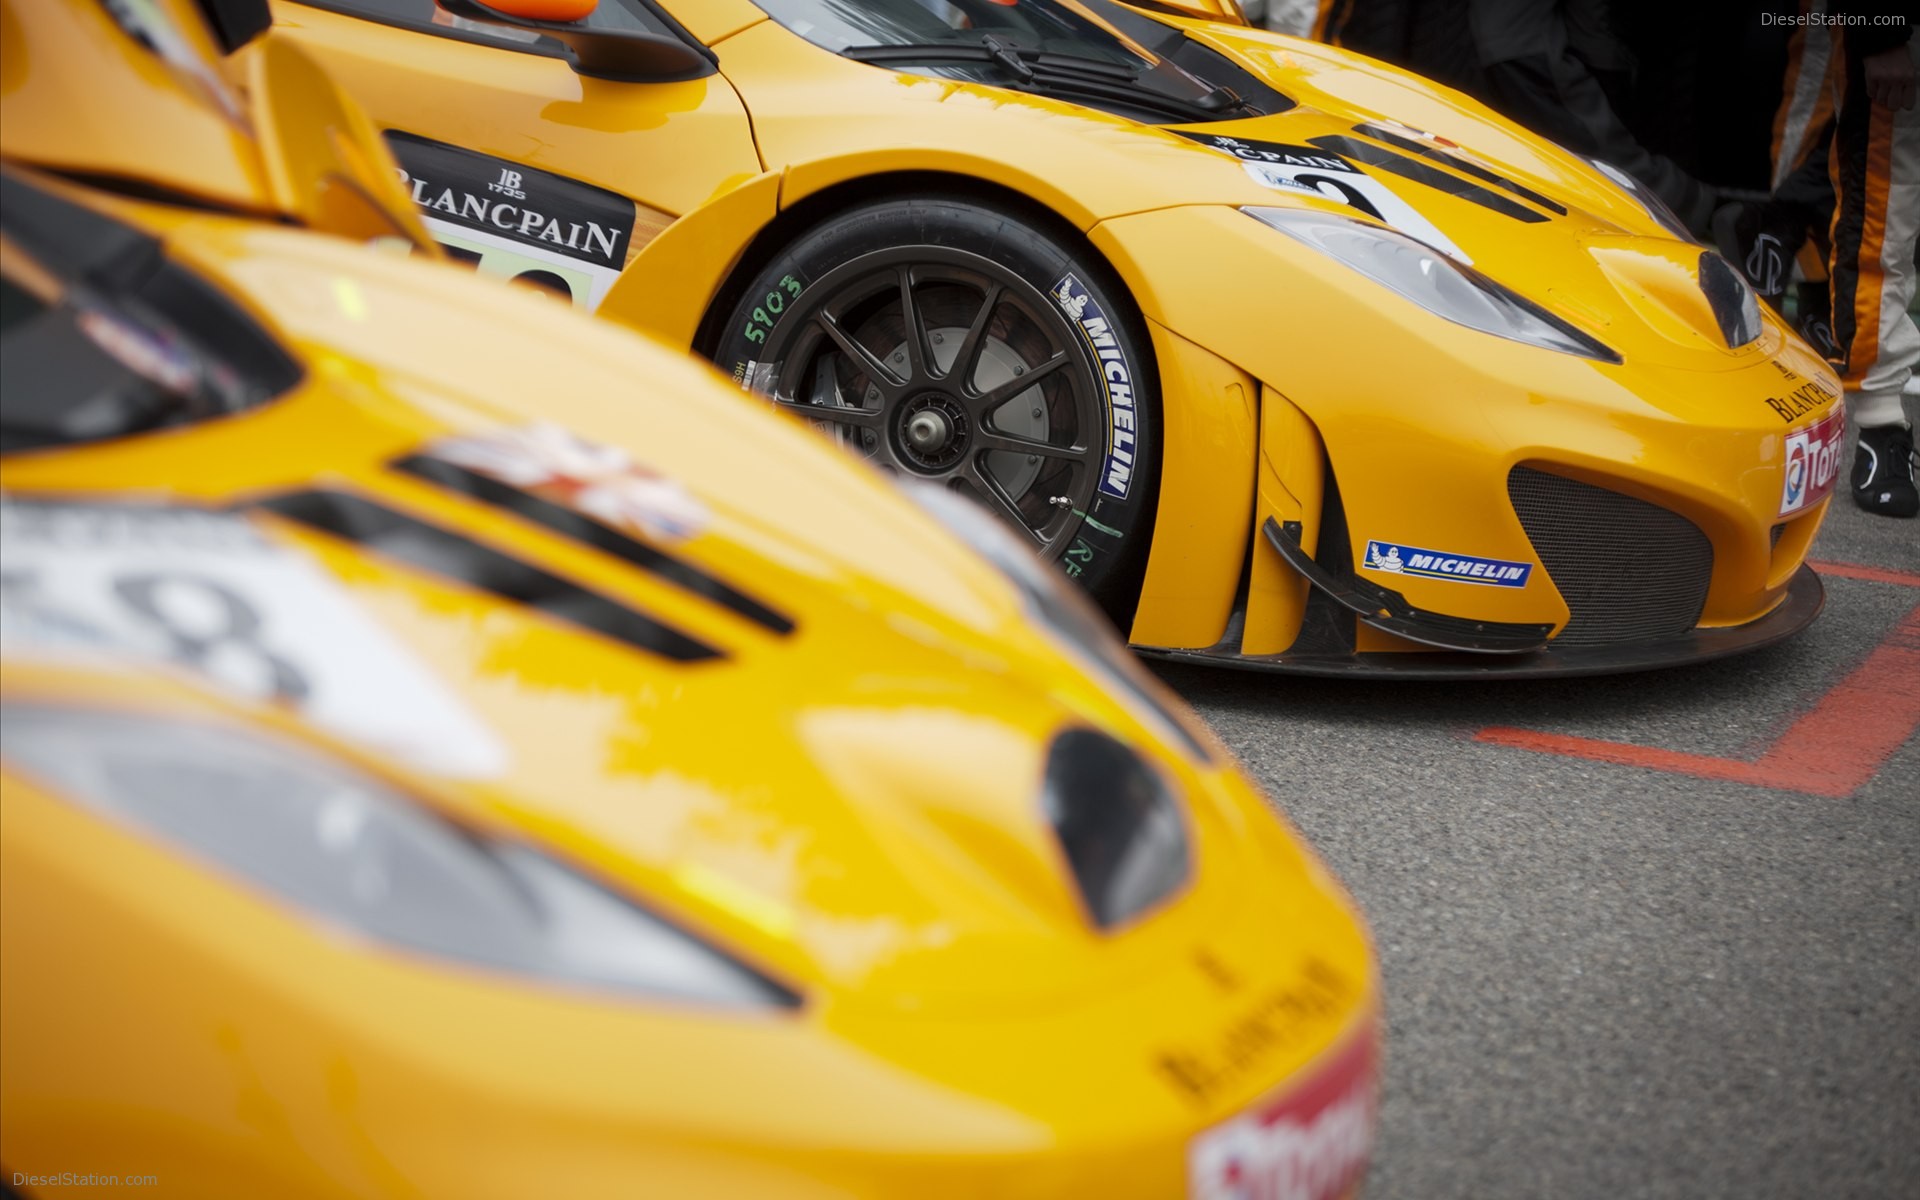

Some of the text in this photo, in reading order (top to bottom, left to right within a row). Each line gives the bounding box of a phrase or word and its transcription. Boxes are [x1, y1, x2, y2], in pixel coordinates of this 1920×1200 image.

[1219, 146, 1351, 171] CPAIN
[487, 182, 527, 200] 1735
[744, 274, 802, 345] 5903
[1083, 316, 1135, 494] MICHELIN
[1408, 553, 1525, 580] MICHELIN
